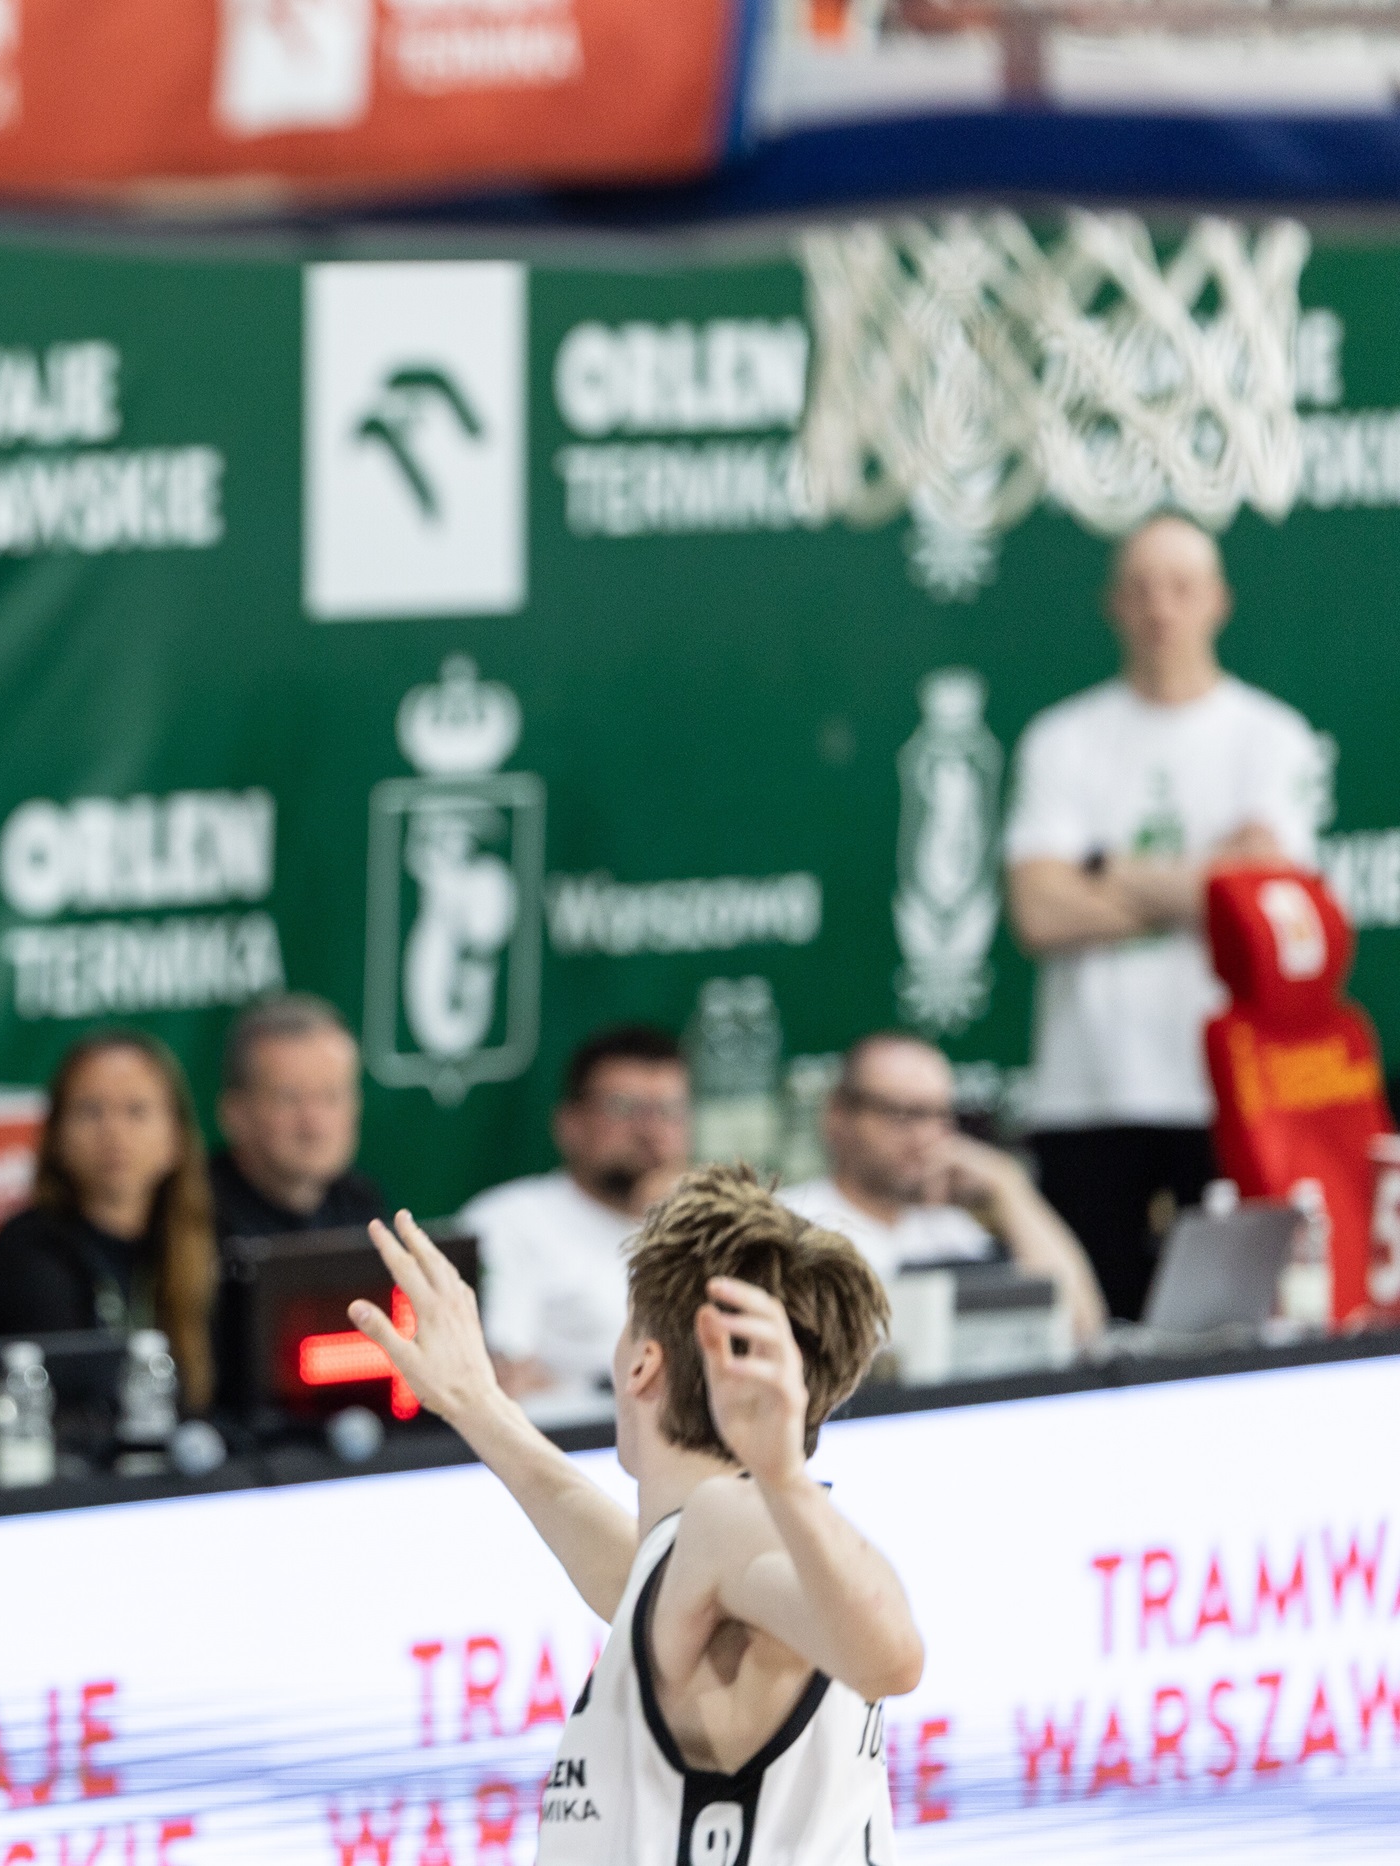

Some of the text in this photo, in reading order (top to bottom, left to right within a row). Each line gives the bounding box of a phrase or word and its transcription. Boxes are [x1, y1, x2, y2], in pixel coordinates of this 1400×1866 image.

[554, 318, 808, 438] ORLEN
[0, 912, 290, 1020] TERMIKA
[1090, 1520, 1400, 1655] TRAMW
